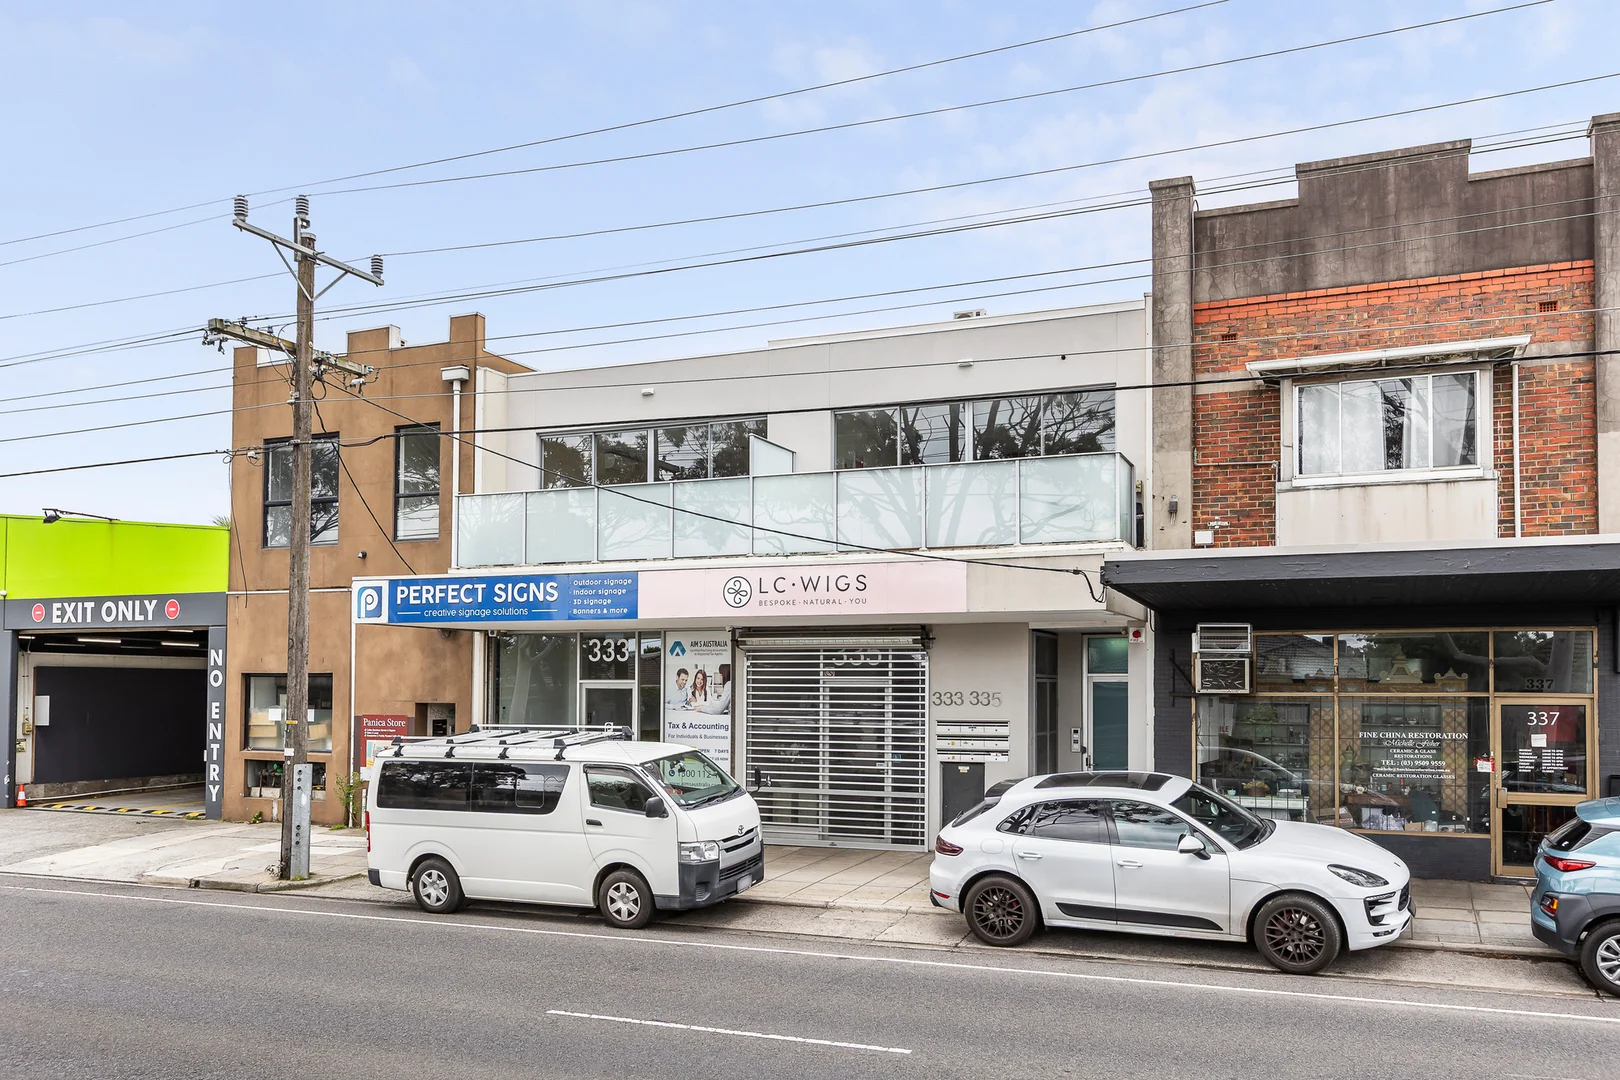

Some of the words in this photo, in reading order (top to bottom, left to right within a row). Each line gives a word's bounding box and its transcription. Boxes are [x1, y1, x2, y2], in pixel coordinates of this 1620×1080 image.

[604, 578, 632, 586] signage
[396, 584, 487, 605] PERFECT
[493, 581, 559, 603] SIGNS
[598, 588, 627, 596] signage
[584, 598, 612, 606] signage
[52, 601, 95, 624] EXIT
[101, 600, 158, 623] ONLY
[423, 609, 456, 617] creative
[458, 608, 491, 618] signage
[492, 607, 529, 616] solutions
[703, 640, 728, 648] AUSTRALIA
[588, 638, 629, 662] 333
[209, 649, 223, 688] NO
[1526, 679, 1554, 689] 337
[932, 691, 964, 706] 333
[969, 690, 1003, 707] 335
[363, 718, 386, 727] Panica
[387, 718, 406, 727] Store
[1527, 711, 1560, 726] 337
[688, 722, 729, 731] Accounting
[1383, 739, 1415, 747] Michelle
[208, 702, 222, 802] ENTRY
